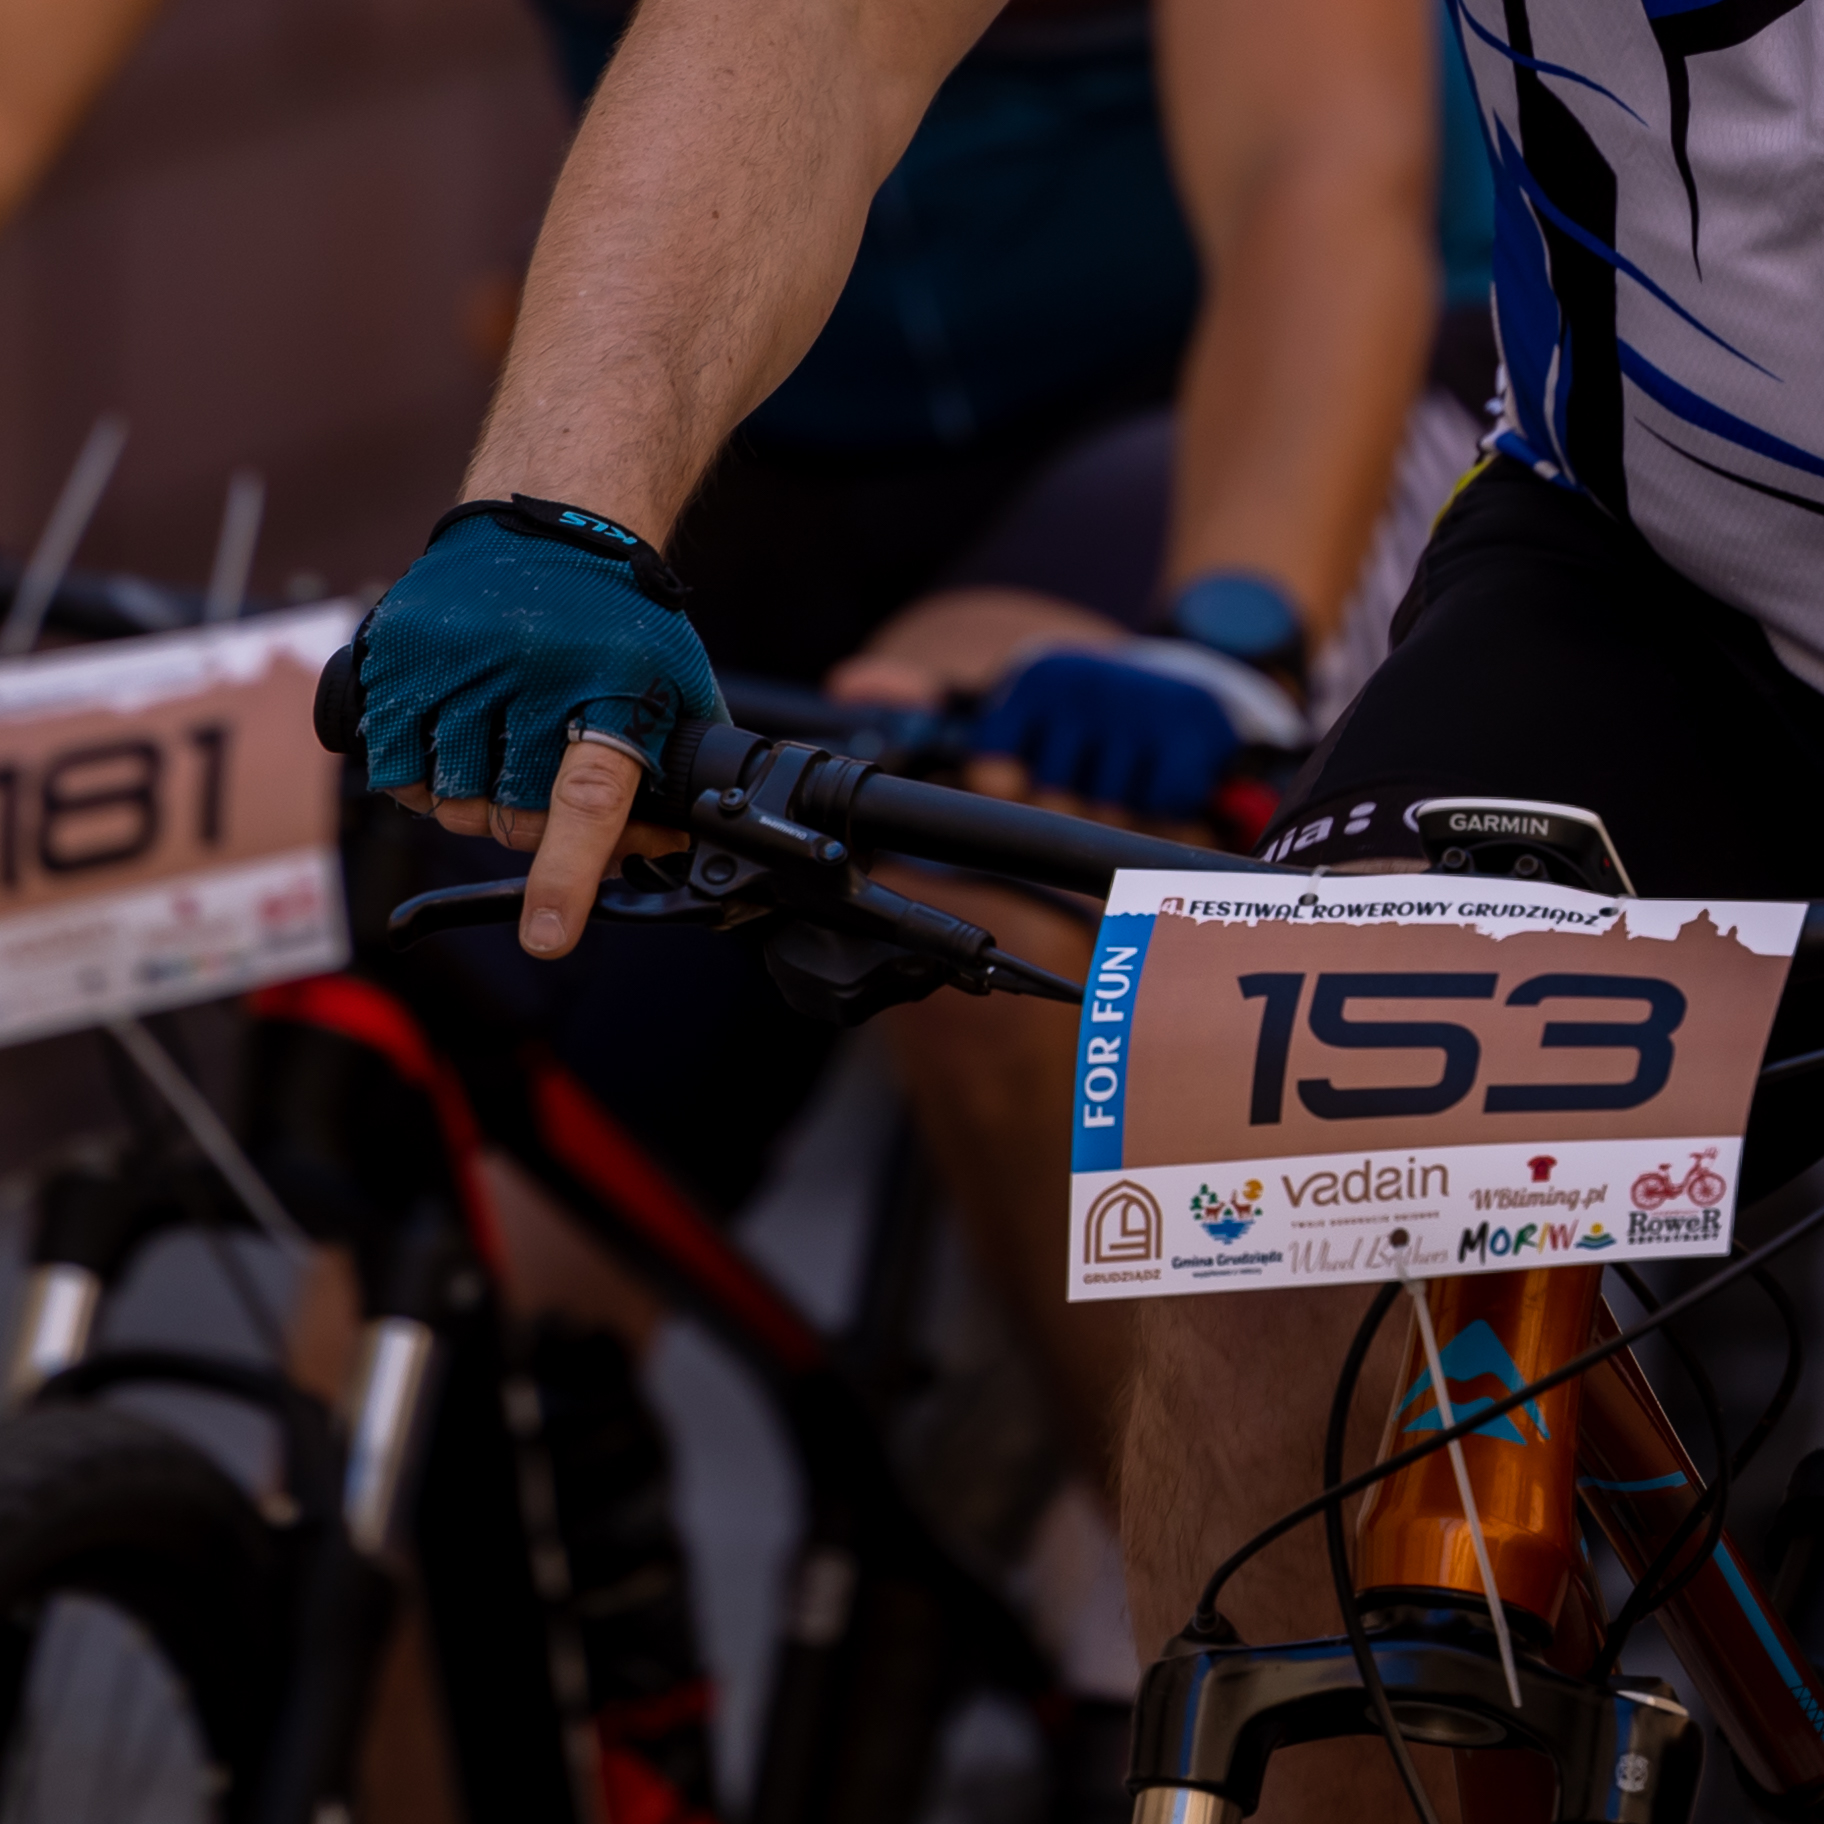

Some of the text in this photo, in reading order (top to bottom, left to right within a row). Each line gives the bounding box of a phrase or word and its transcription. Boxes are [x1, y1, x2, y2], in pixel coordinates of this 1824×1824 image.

[1448, 812, 1550, 837] GARMIN
[1311, 900, 1454, 920] ROWEROWY
[1457, 901, 1600, 927] GRUDZIĄDZ
[1082, 946, 1139, 1129] FOR FUN
[1237, 972, 1689, 1127] 153
[1281, 1156, 1449, 1208] vadain
[1171, 1255, 1214, 1270] Gmina
